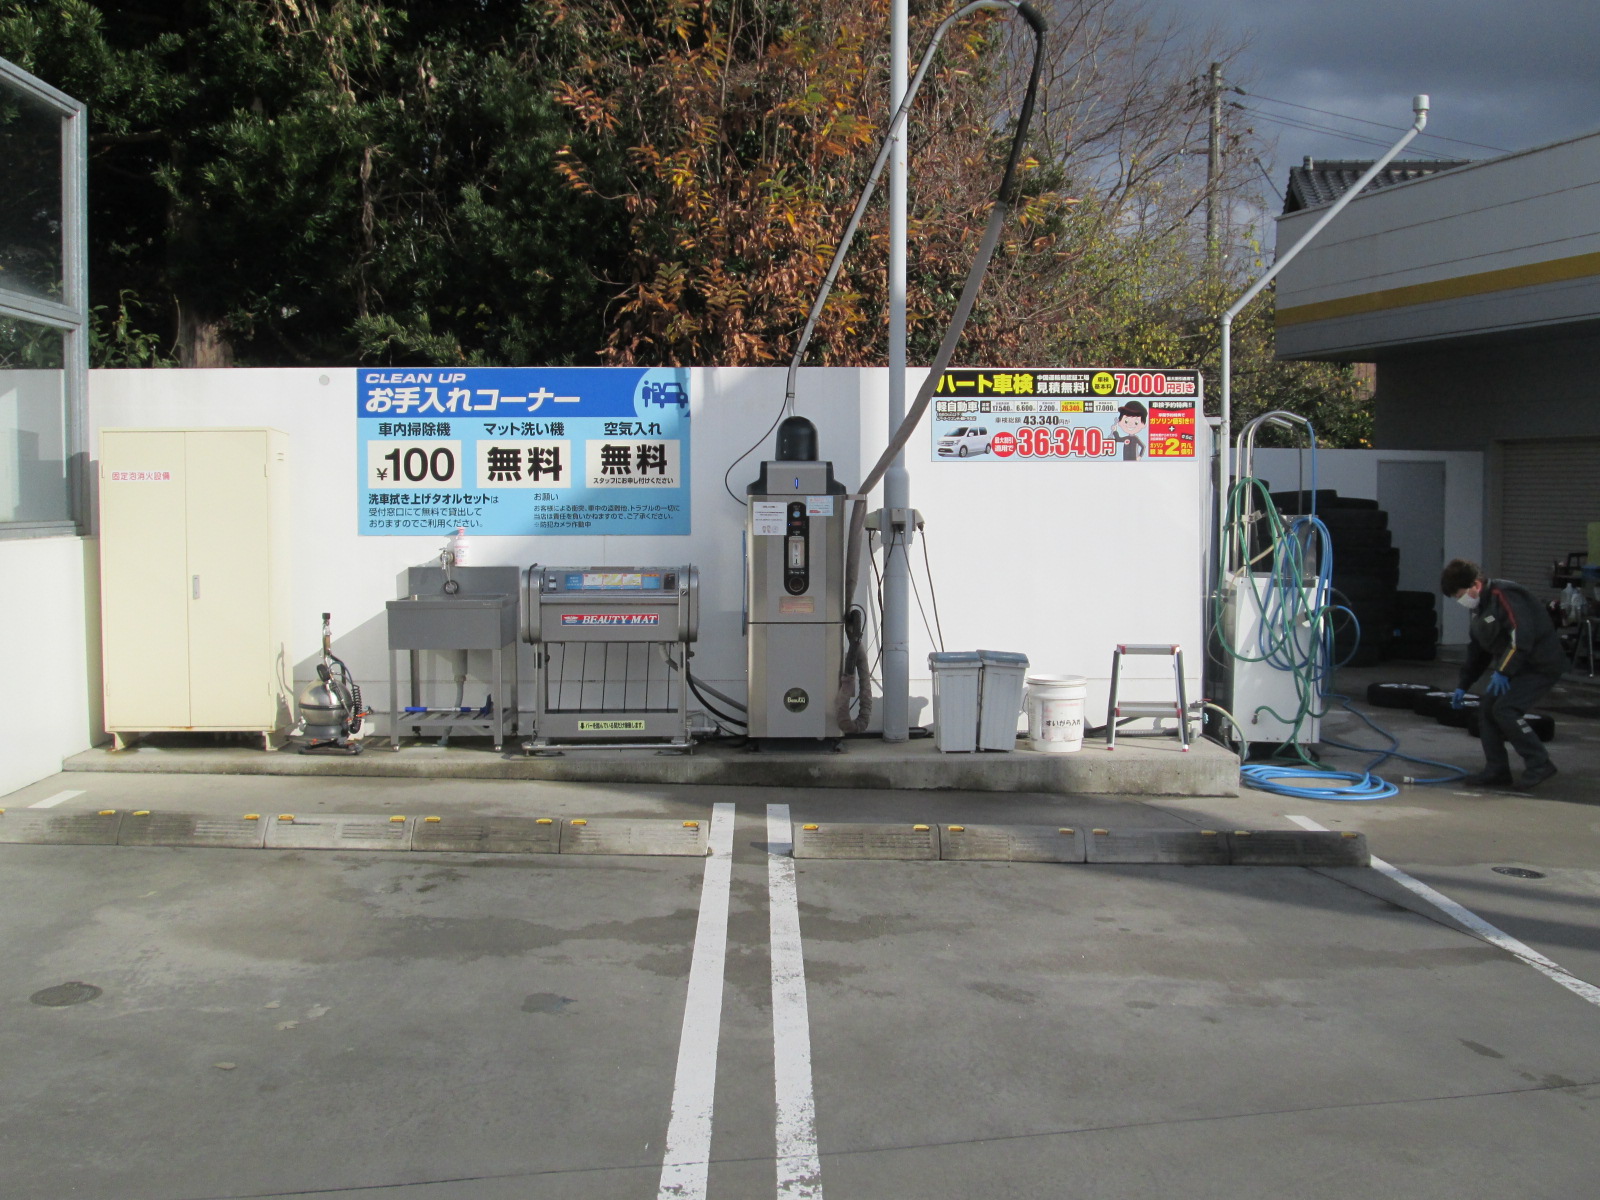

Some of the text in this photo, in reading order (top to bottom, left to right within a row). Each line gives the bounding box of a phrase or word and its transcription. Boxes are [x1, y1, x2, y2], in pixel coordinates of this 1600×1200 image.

[365, 373, 466, 383] CLEAN UP
[936, 374, 1034, 394] ハート車検
[1114, 373, 1195, 395] 7,000円引き
[1036, 382, 1089, 394] 見積無料!
[365, 387, 581, 413] お手入れコーナー
[936, 400, 979, 412] 軽自動車
[378, 422, 451, 437] 車内掃除機
[484, 422, 565, 437] マット洗い機
[603, 421, 662, 436] 空気入れ
[1017, 426, 1116, 458] 36,340円
[376, 447, 455, 481] ¥100
[487, 446, 563, 482] 無料
[600, 443, 668, 475] 無料
[111, 471, 171, 481] 固定泡消火設備
[593, 477, 674, 485] スタッフにお申し付けください
[368, 493, 499, 505] 洗車拭き上げタオルセットは
[533, 492, 559, 501] お願い
[368, 506, 482, 517] 受付窓口にて無料で貸出して
[368, 518, 484, 529] おりますのでご利用ください。
[582, 615, 658, 624] BEAUTY MAT
